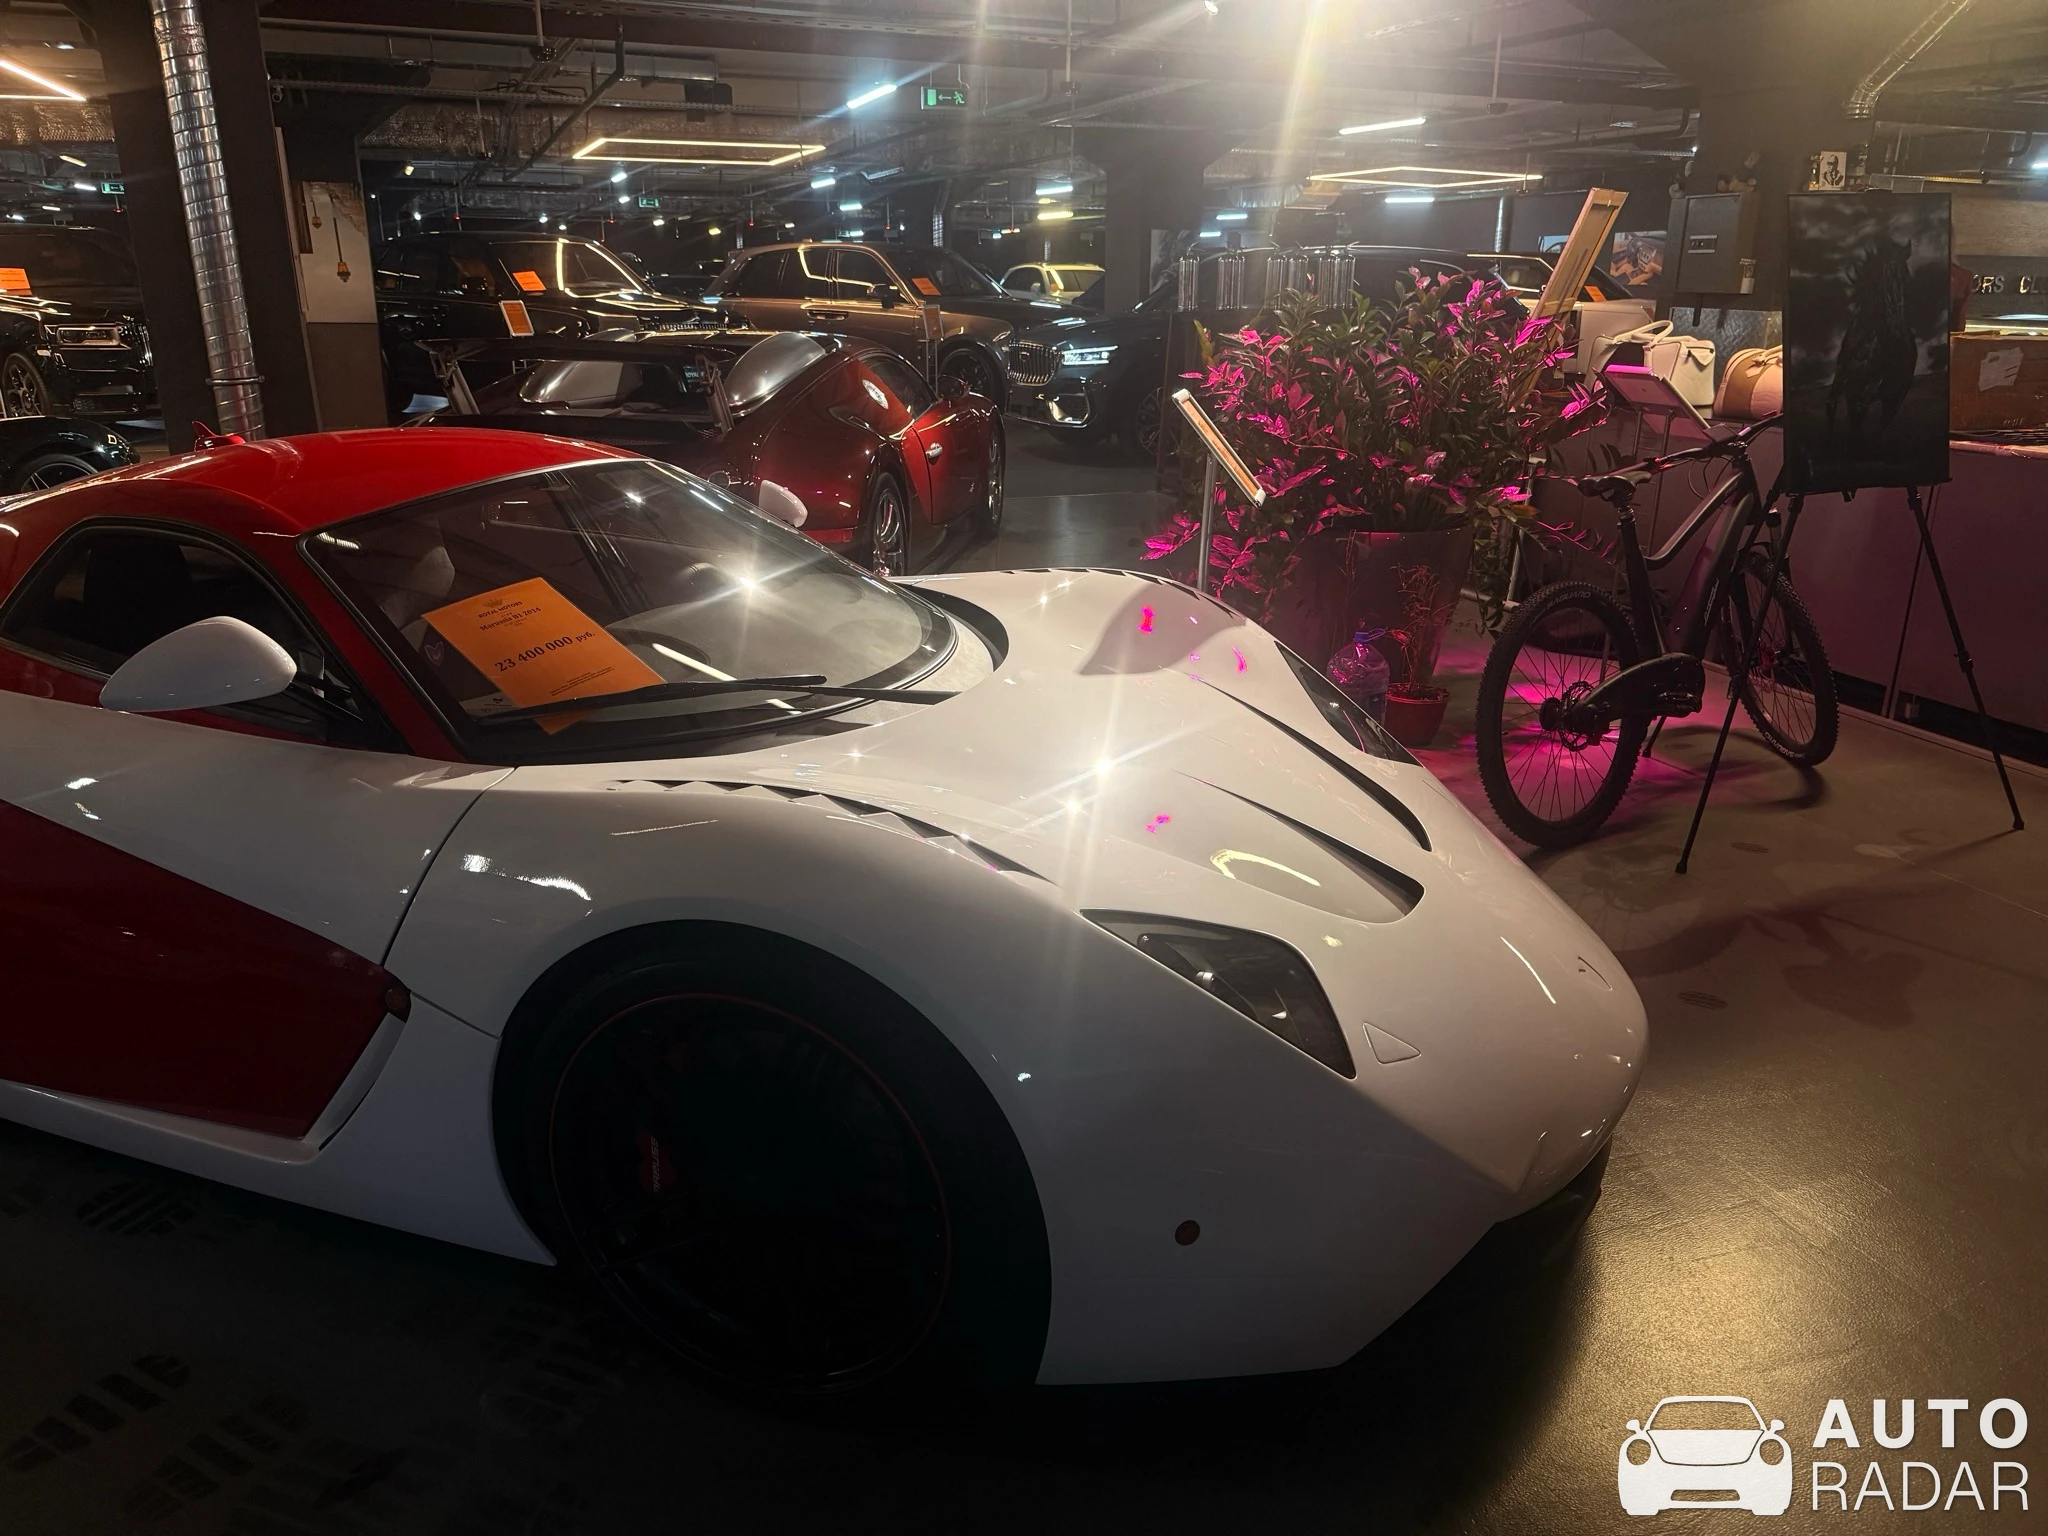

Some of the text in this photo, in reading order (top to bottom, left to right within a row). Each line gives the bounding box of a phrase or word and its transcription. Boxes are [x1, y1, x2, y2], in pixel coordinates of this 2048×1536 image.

[480, 617, 513, 631] Marussia
[523, 607, 541, 616] 2014
[494, 631, 596, 672] 23 400 000 руб.
